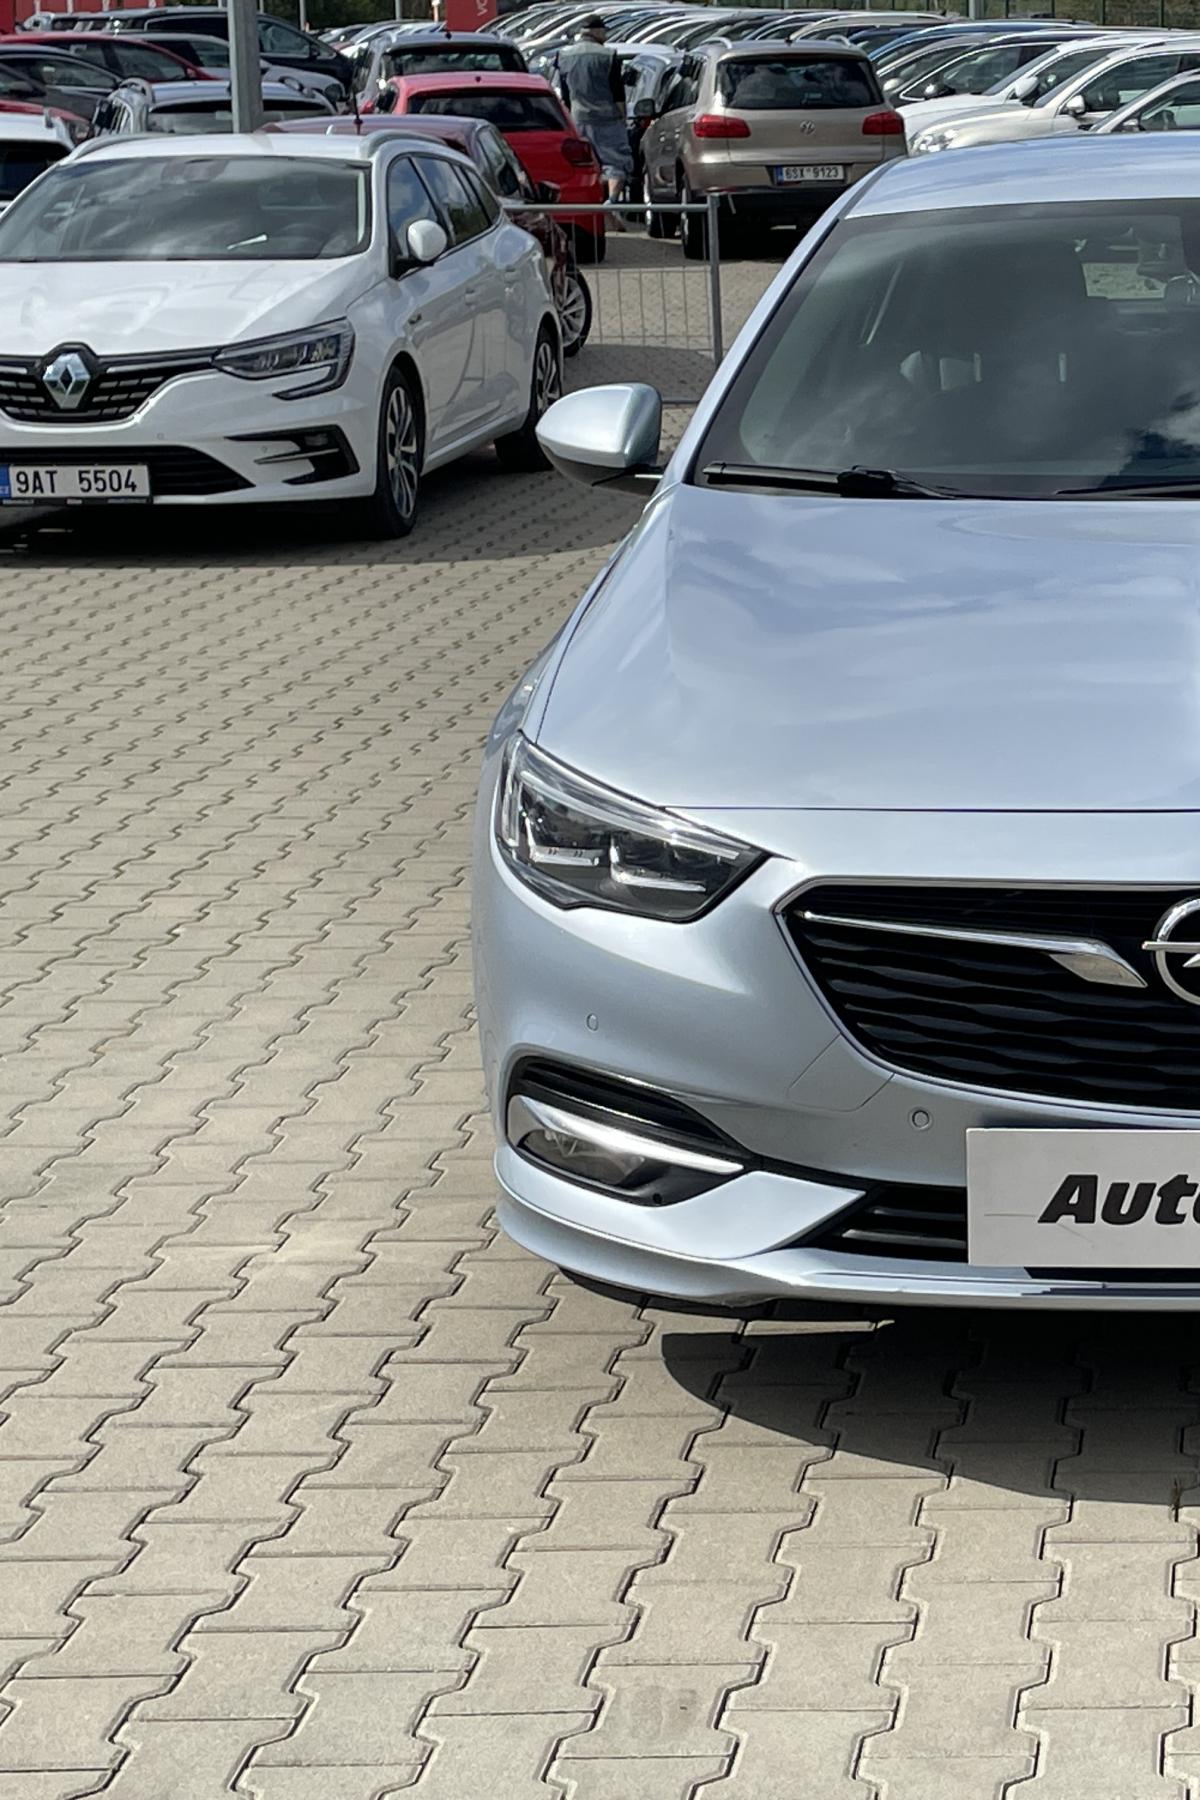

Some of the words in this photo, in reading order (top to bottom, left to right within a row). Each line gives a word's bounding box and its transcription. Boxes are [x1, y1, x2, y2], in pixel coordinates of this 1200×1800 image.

[812, 166, 839, 178] 9123
[15, 470, 58, 494] 9AT
[78, 469, 137, 493] 5504
